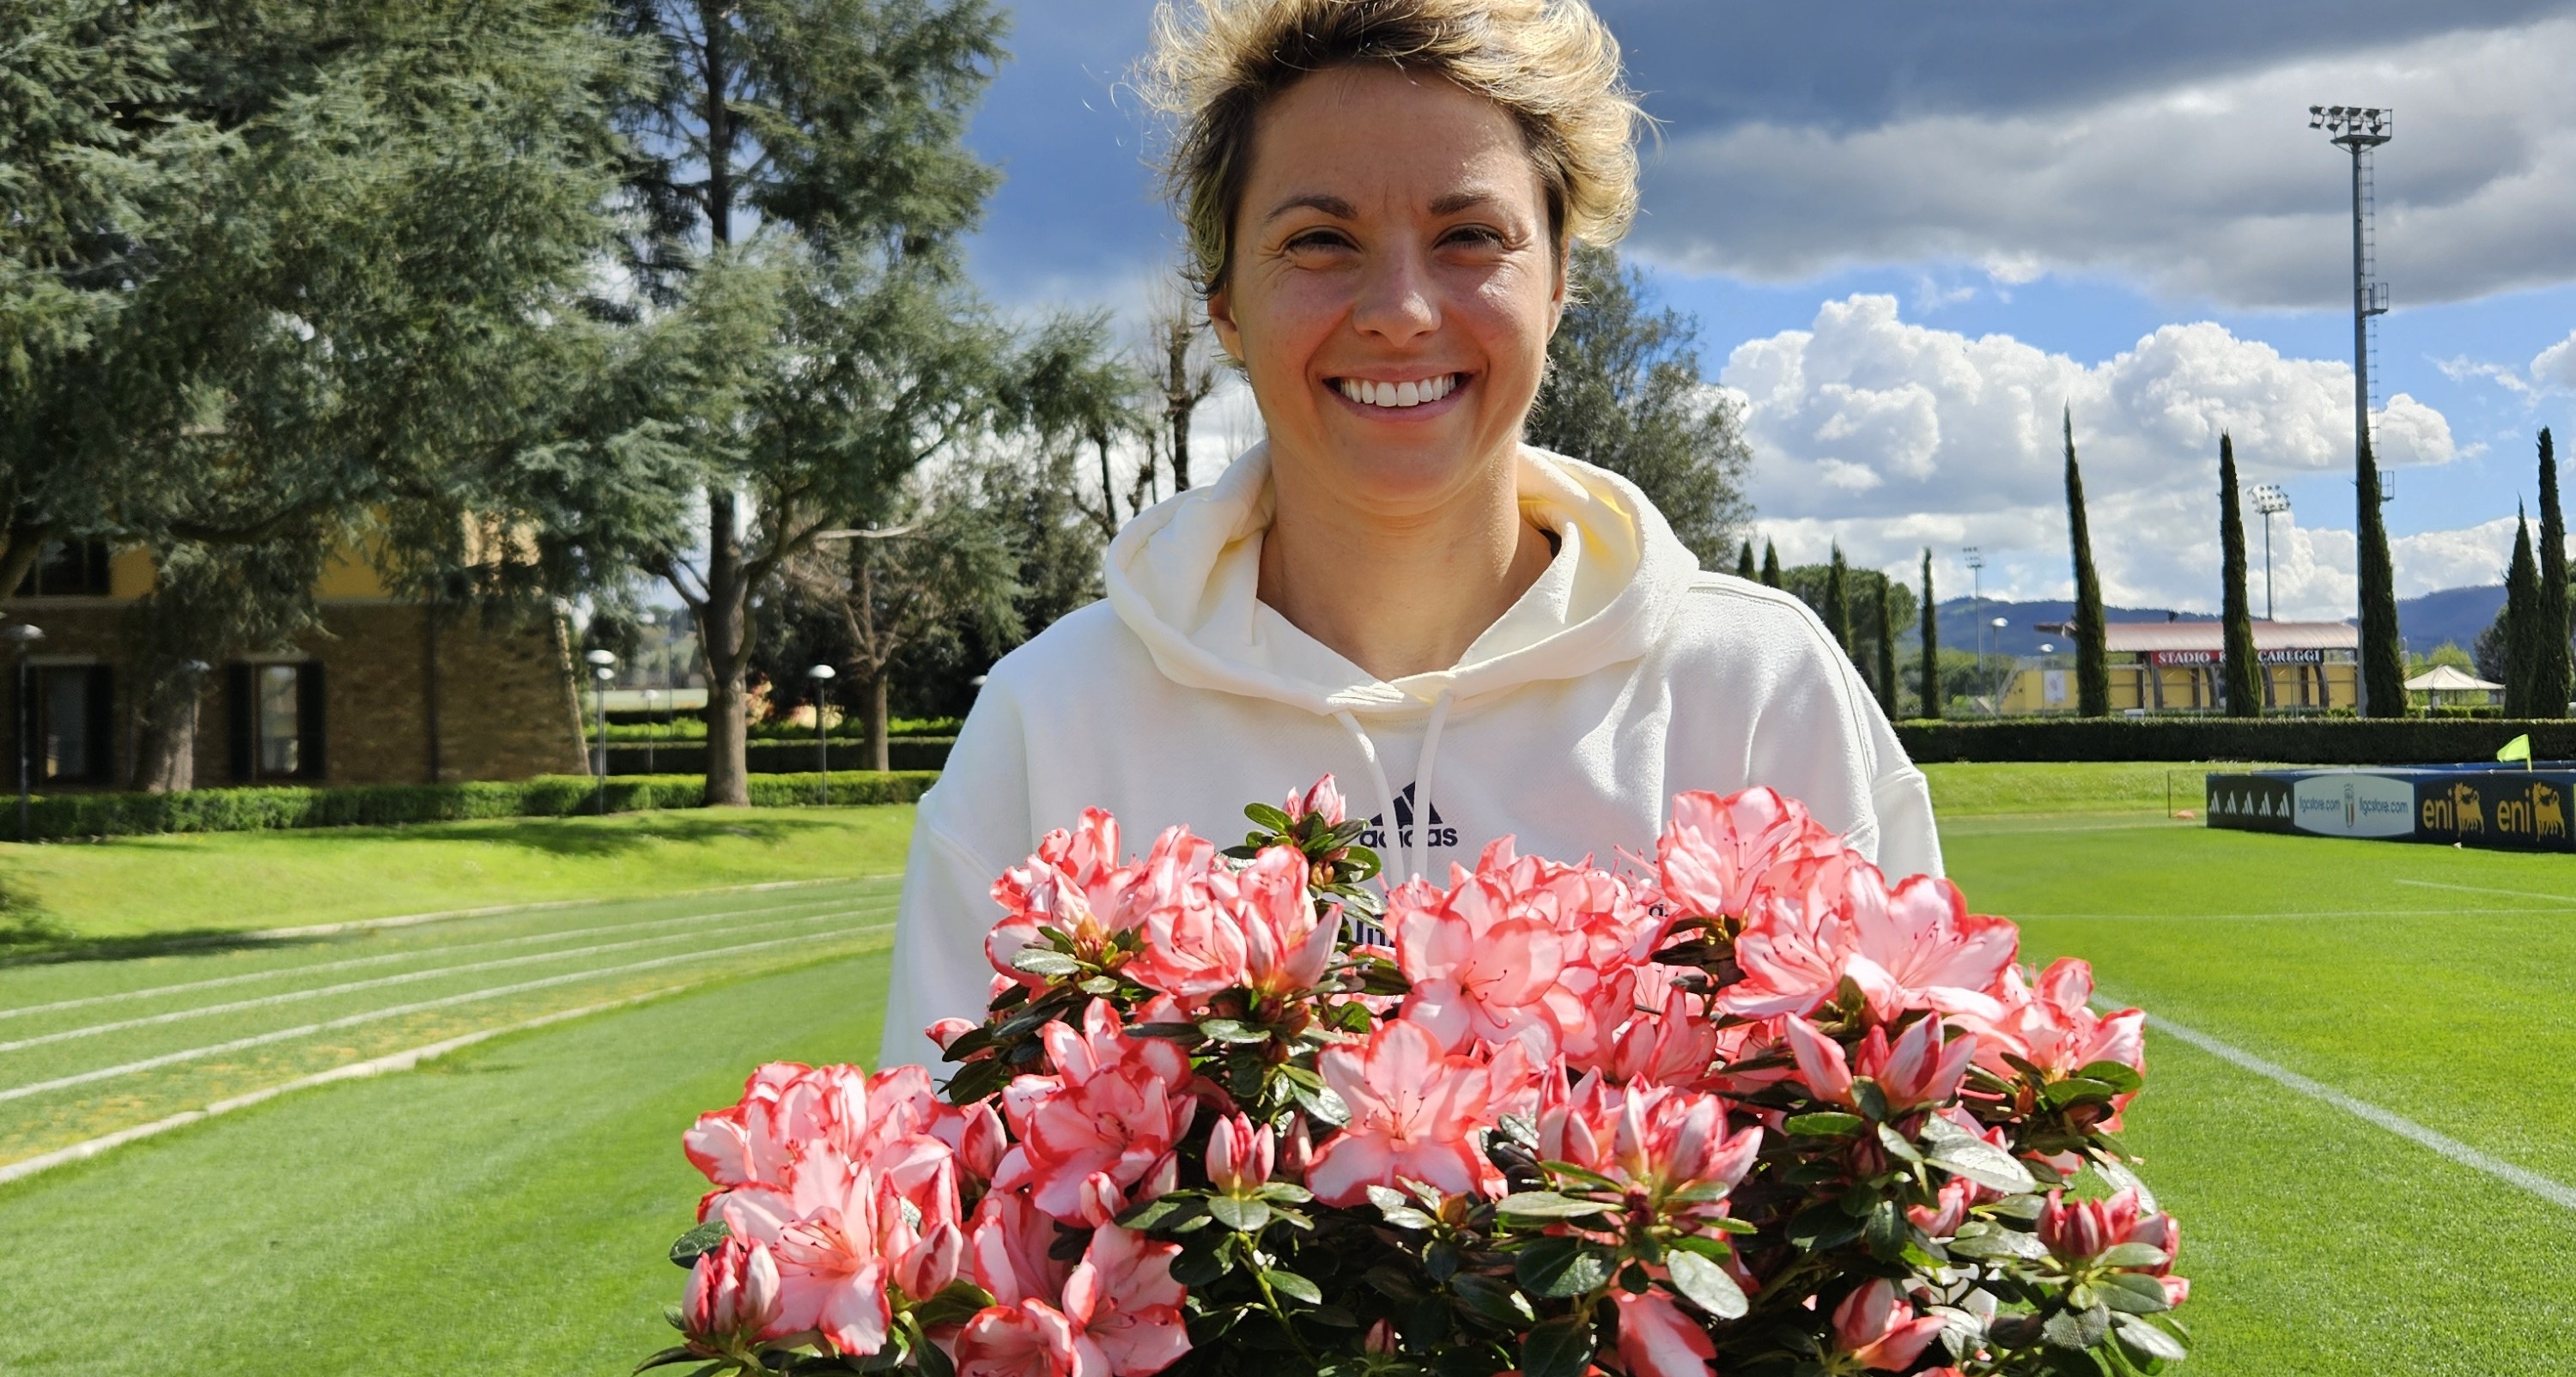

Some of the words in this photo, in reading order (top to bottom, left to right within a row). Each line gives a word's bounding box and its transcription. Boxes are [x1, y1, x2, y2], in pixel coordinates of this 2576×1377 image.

[2158, 651, 2210, 664] STADIO
[2257, 649, 2320, 664] CAREGGI
[2422, 787, 2453, 830] eni
[2497, 787, 2530, 834] eni
